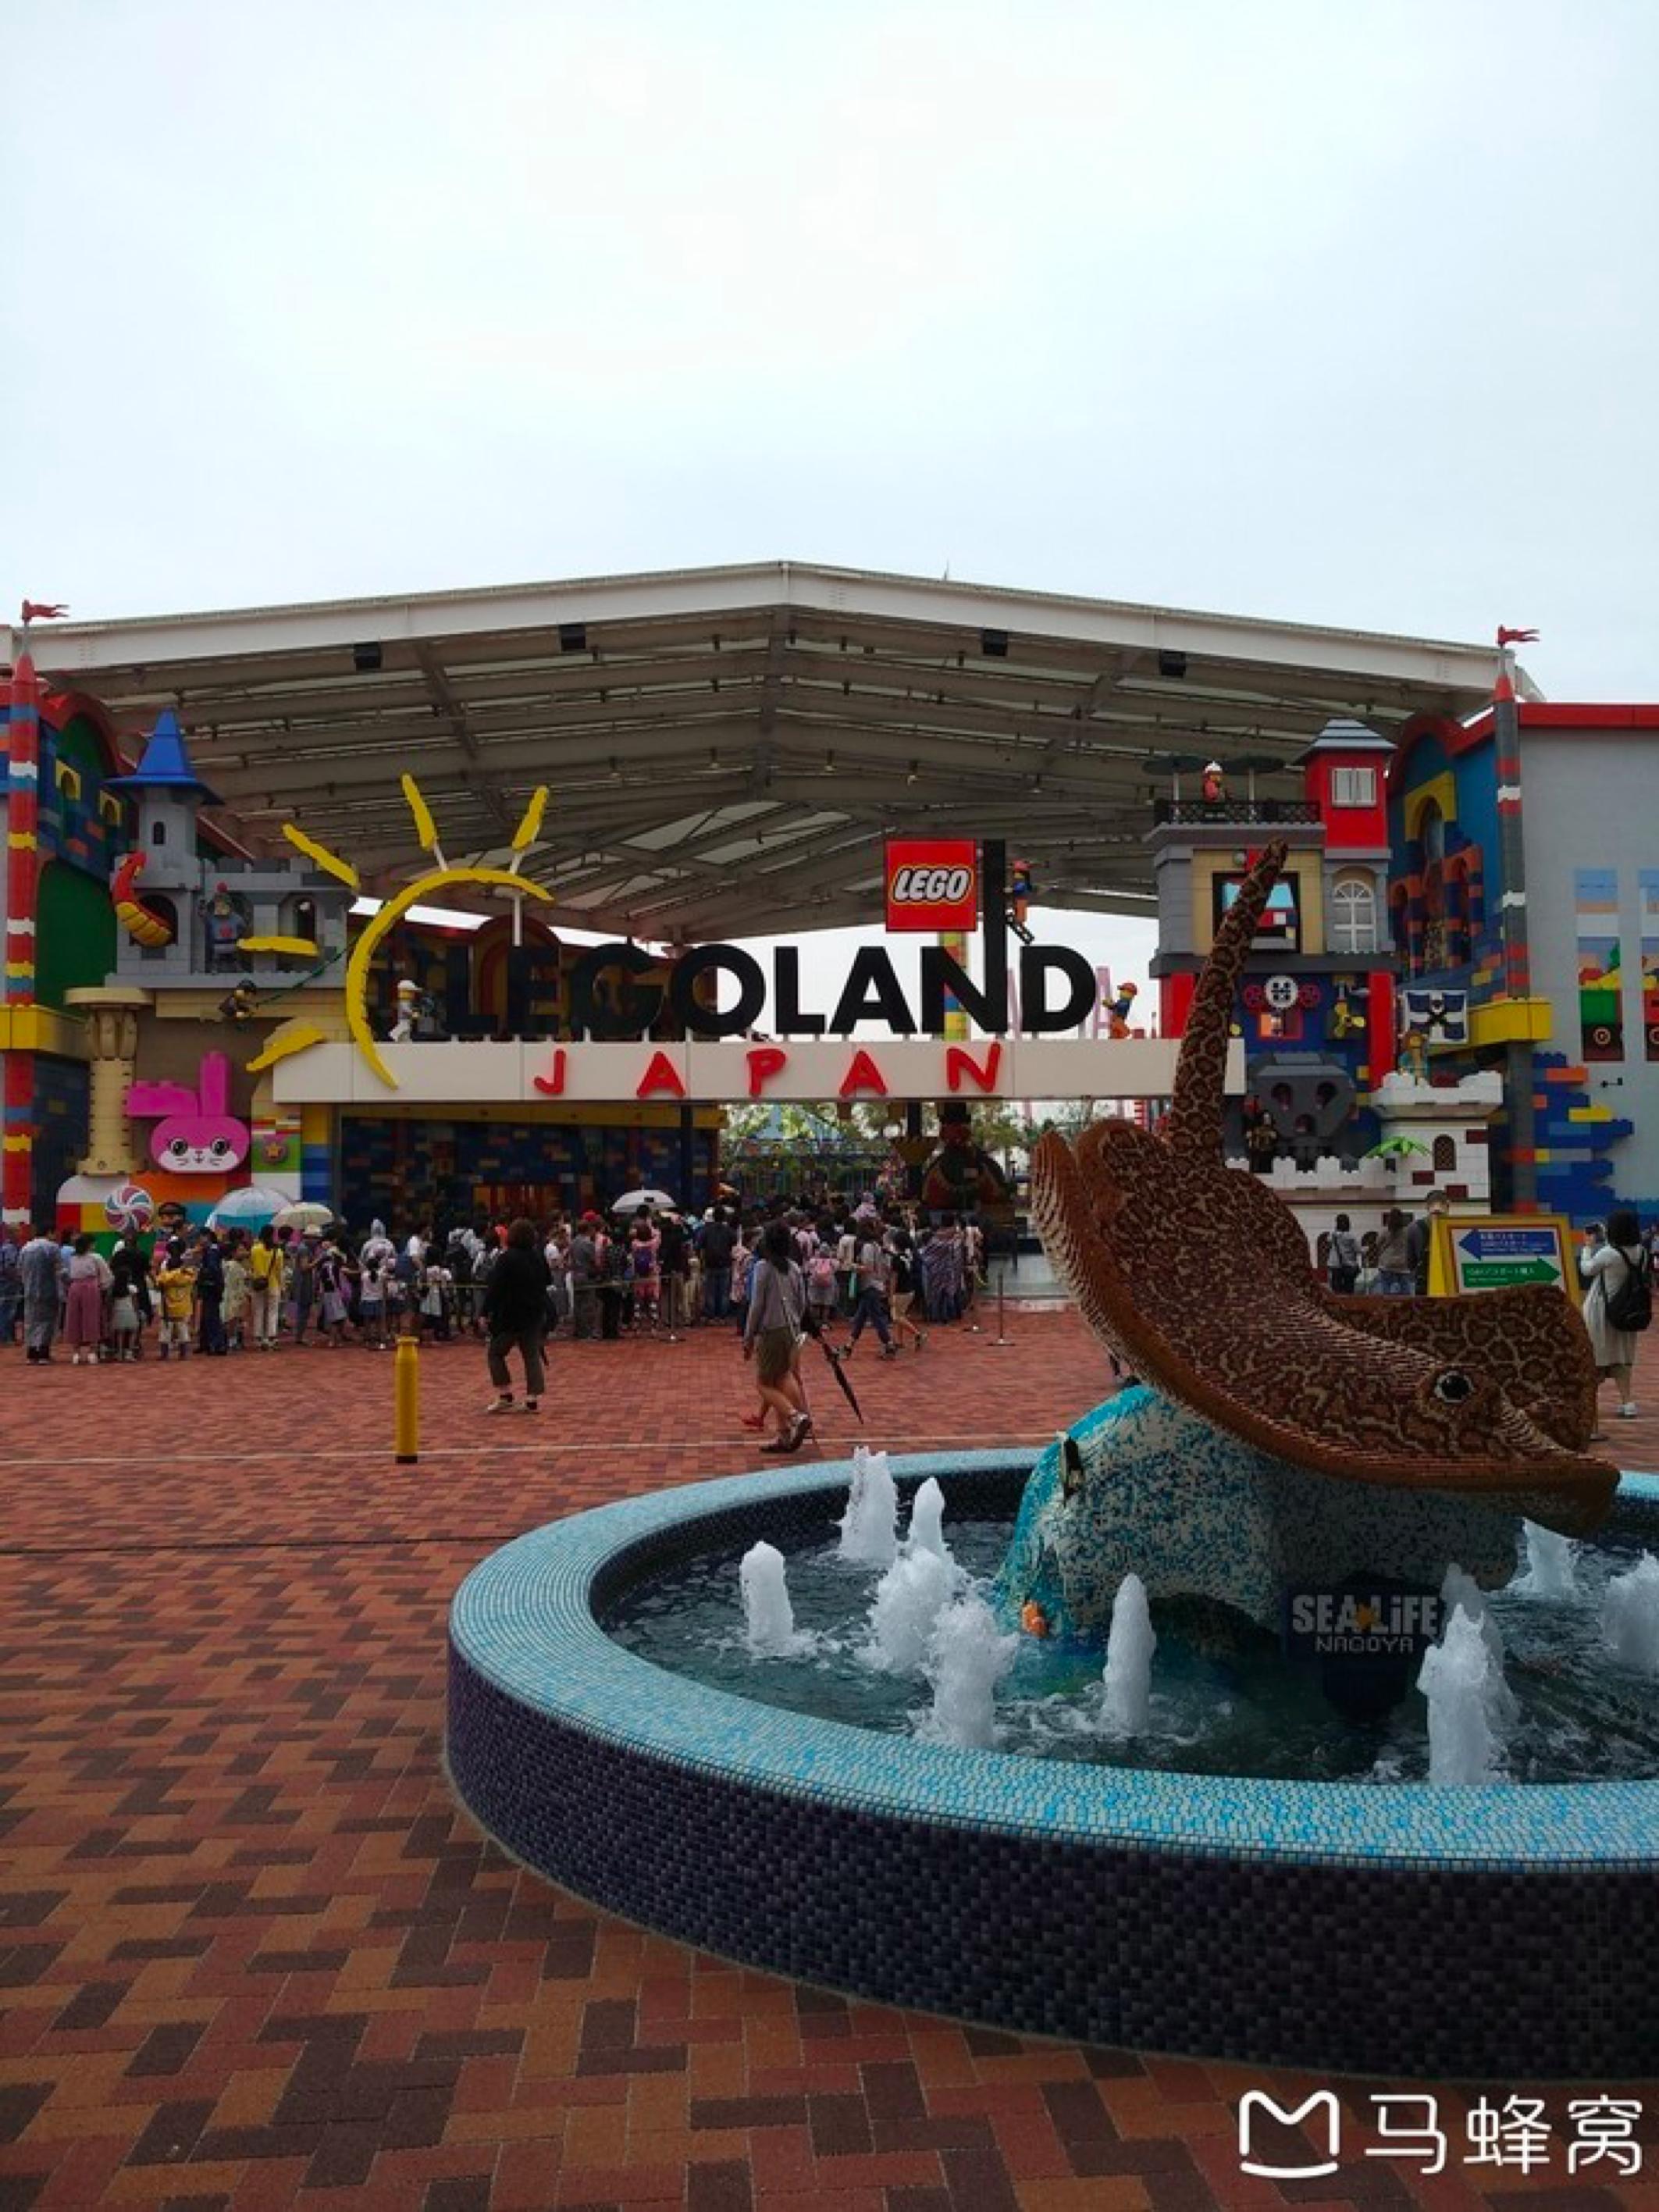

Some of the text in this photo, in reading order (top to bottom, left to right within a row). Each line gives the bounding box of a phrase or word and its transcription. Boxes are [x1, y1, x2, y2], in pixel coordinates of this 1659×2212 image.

[894, 869, 970, 901] LEGO
[448, 944, 1096, 1036] LEGOLAND
[534, 1042, 1001, 1096] JAPAN
[1292, 1594, 1361, 1633] SEA
[1315, 1637, 1413, 1653] NAGOYA
